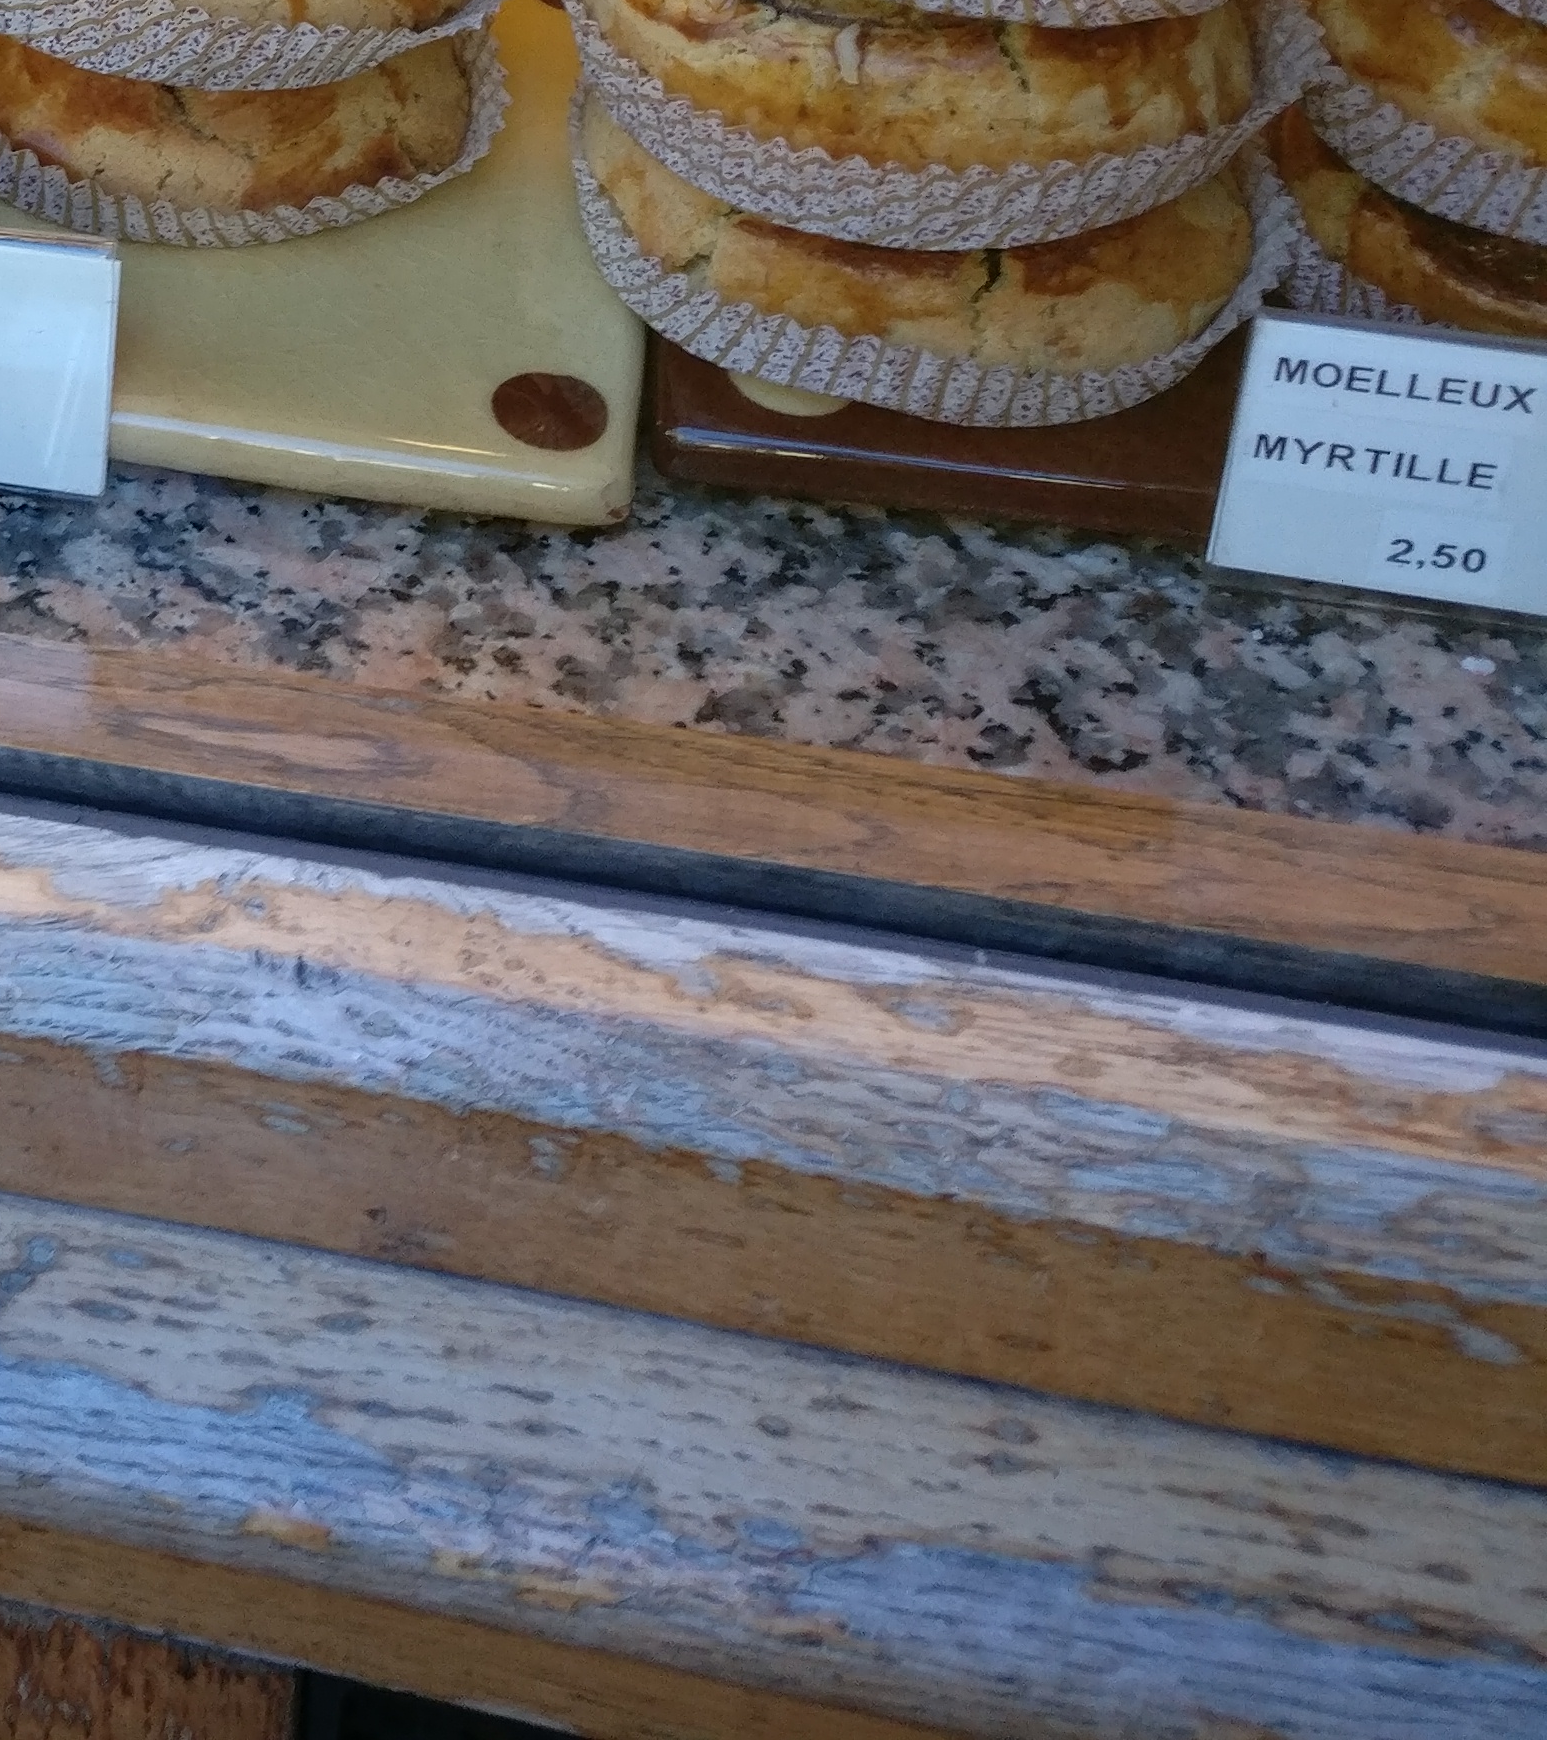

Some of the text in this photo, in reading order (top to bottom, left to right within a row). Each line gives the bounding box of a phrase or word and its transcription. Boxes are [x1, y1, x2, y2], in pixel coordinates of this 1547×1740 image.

[1273, 356, 1539, 414] MOELLEUX
[1253, 433, 1499, 491] MYRTILLE
[1385, 537, 1488, 574] 2,50
